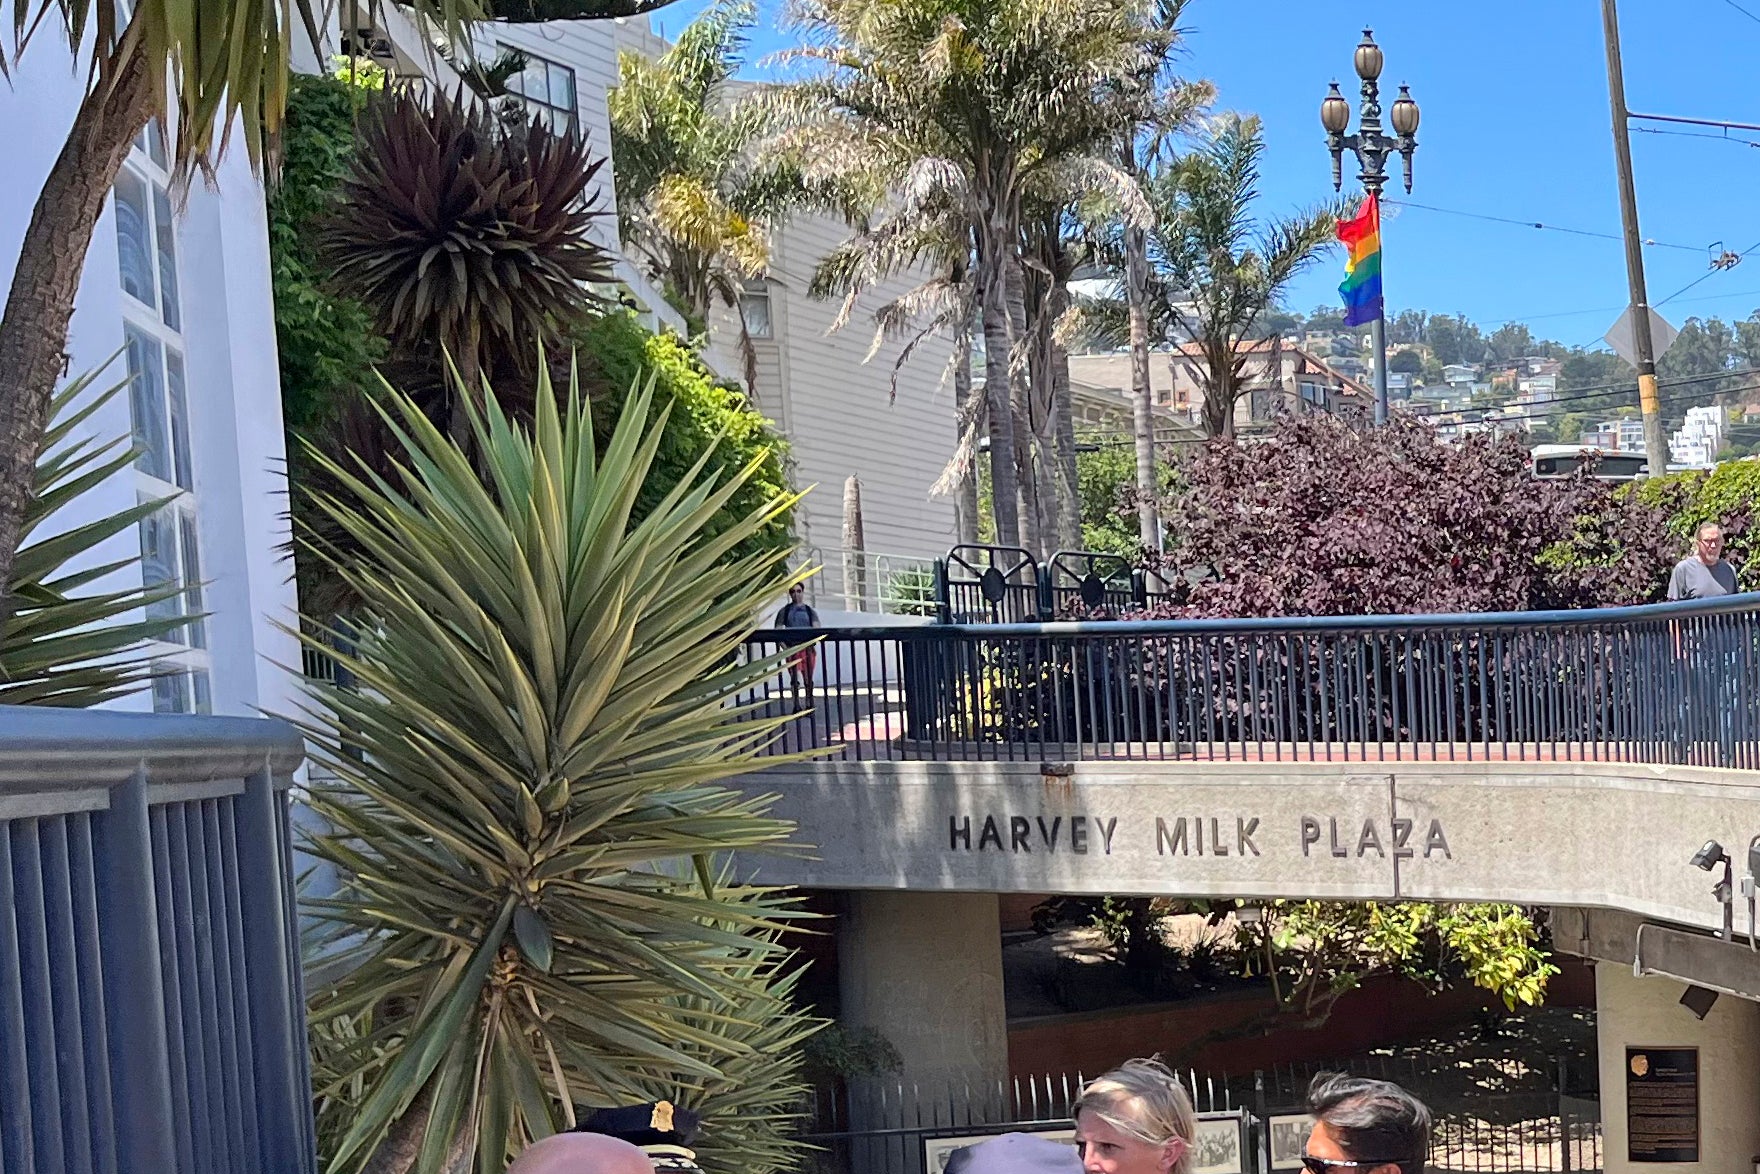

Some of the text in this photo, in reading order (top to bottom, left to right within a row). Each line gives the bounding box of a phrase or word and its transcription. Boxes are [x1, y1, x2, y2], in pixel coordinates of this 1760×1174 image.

[949, 815, 1453, 859] HARVEY MILK PLAZA
